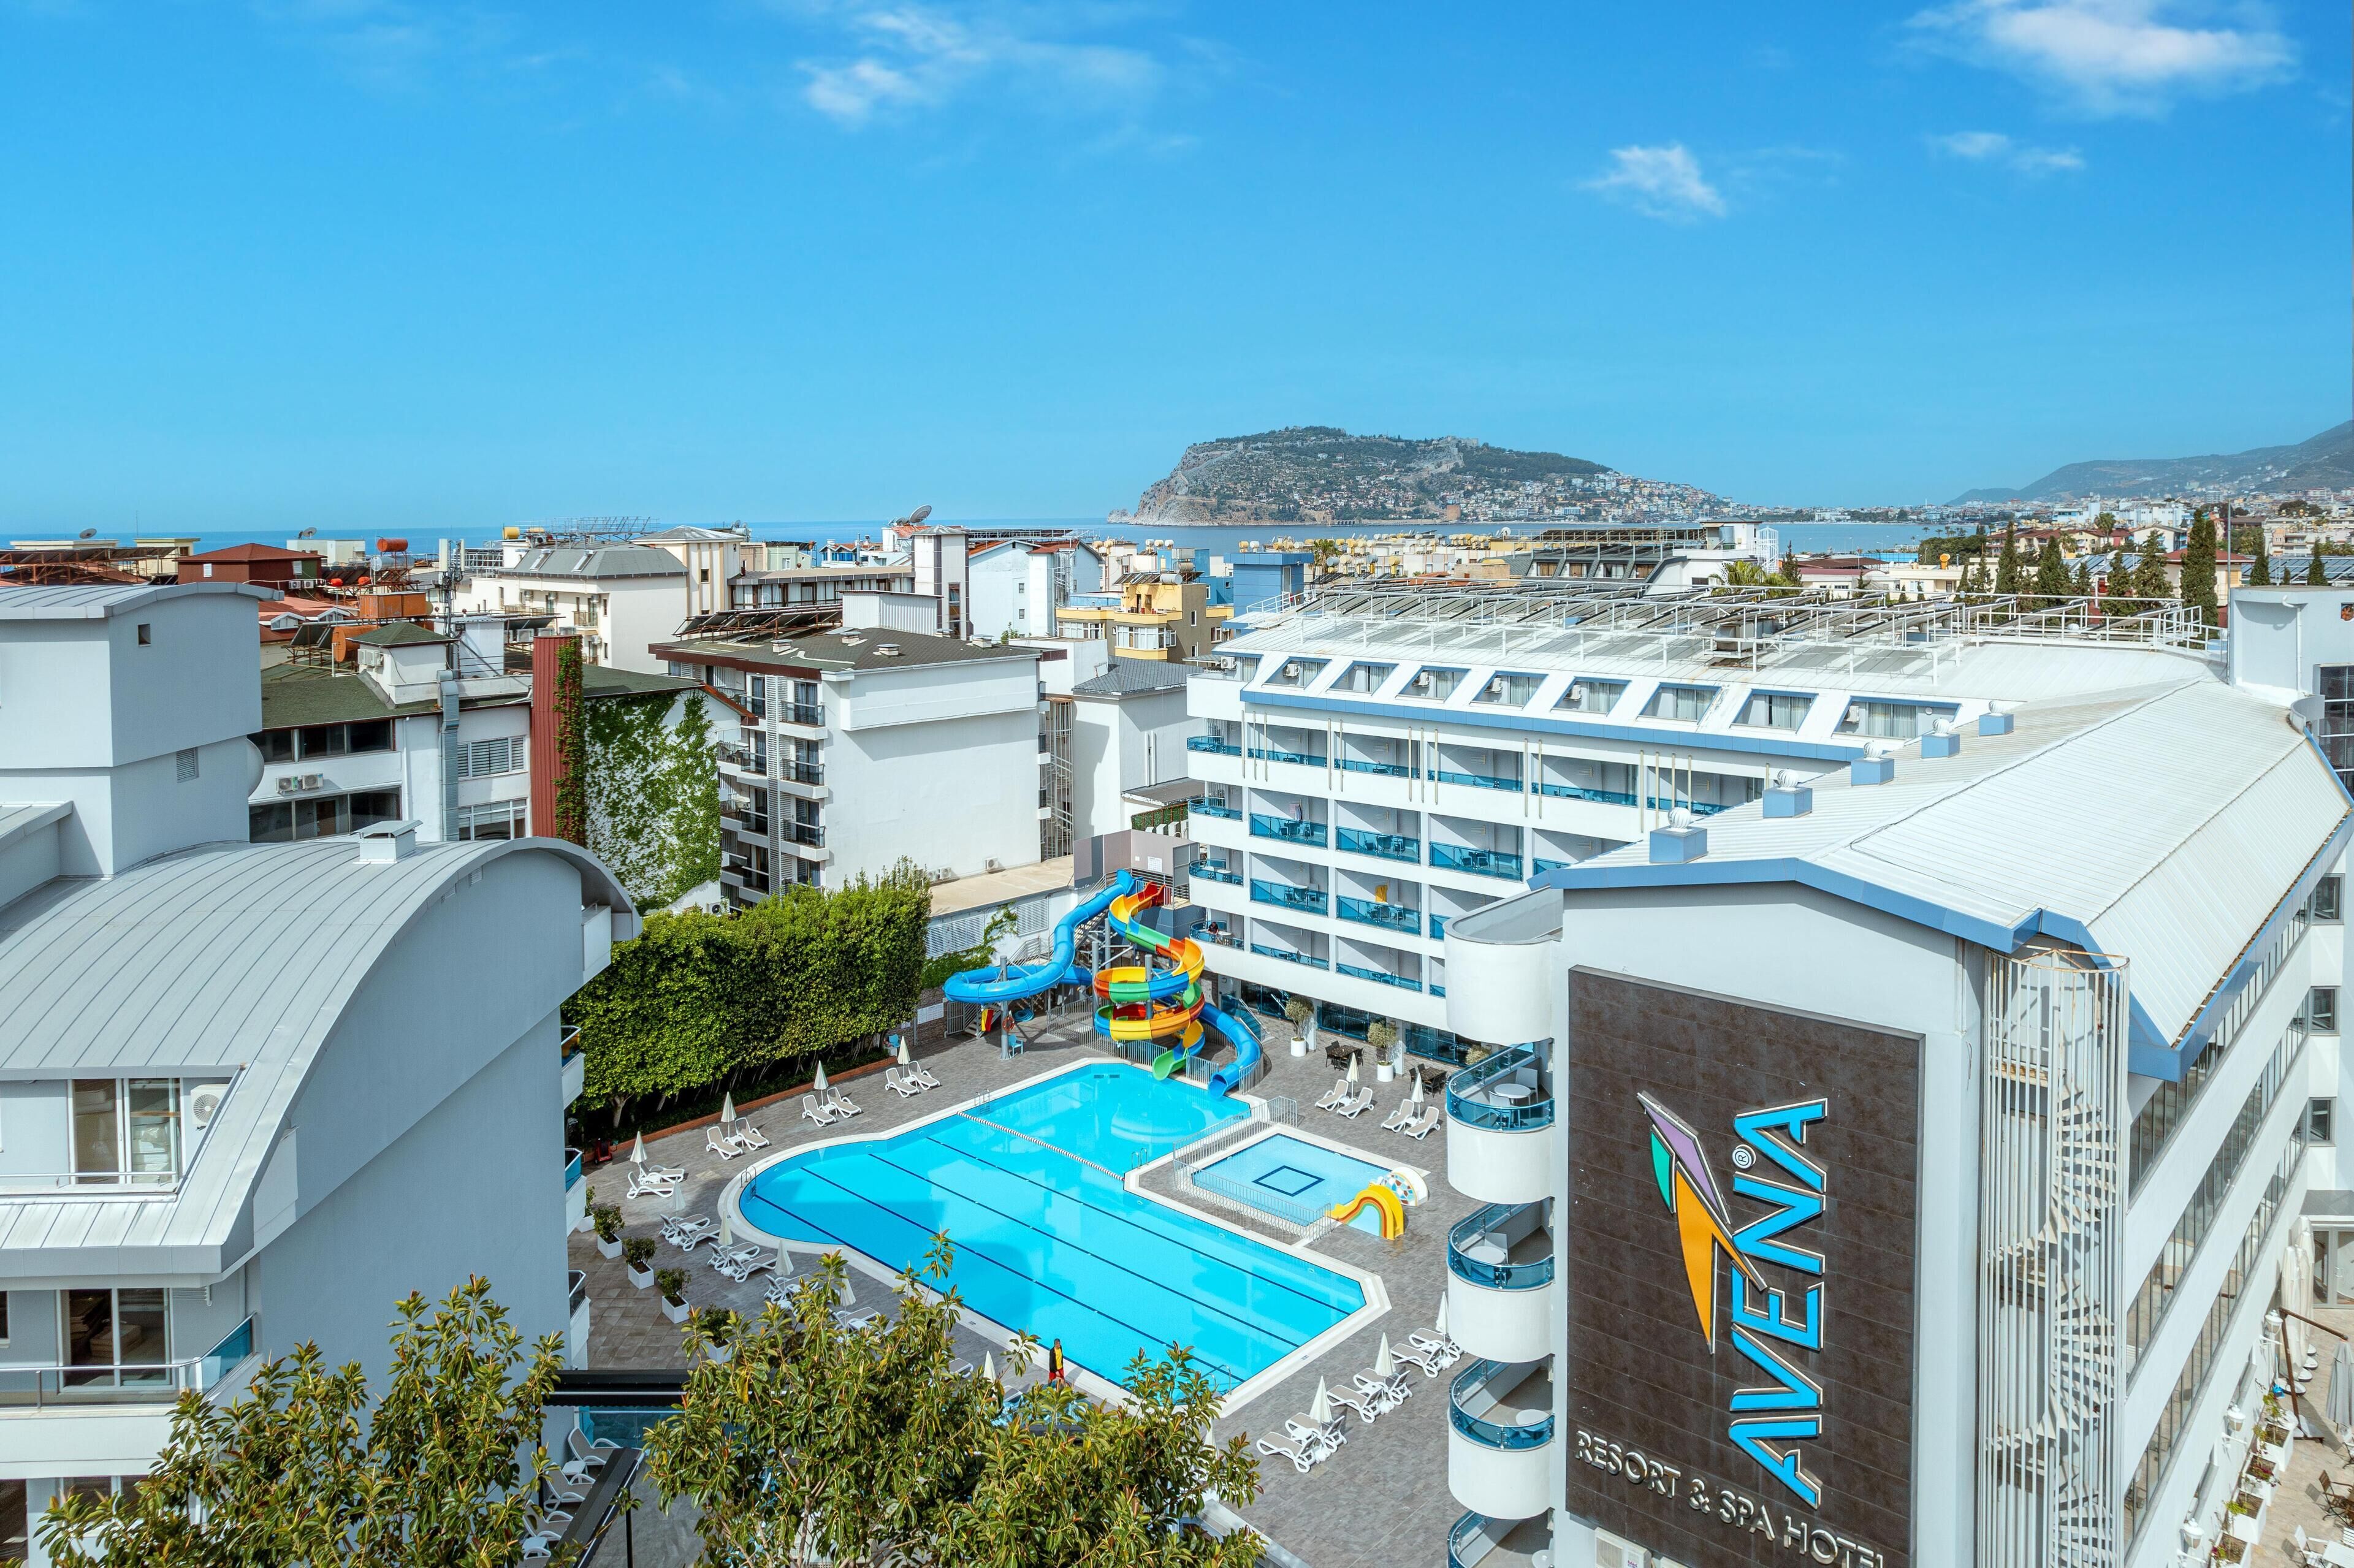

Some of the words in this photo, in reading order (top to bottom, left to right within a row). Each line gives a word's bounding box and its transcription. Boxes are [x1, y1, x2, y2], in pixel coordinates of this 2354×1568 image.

[1729, 1097, 1828, 1510] AVENA
[1575, 1430, 1681, 1499] RESORT
[1688, 1479, 1711, 1514] &
[1719, 1490, 1775, 1542] SPA
